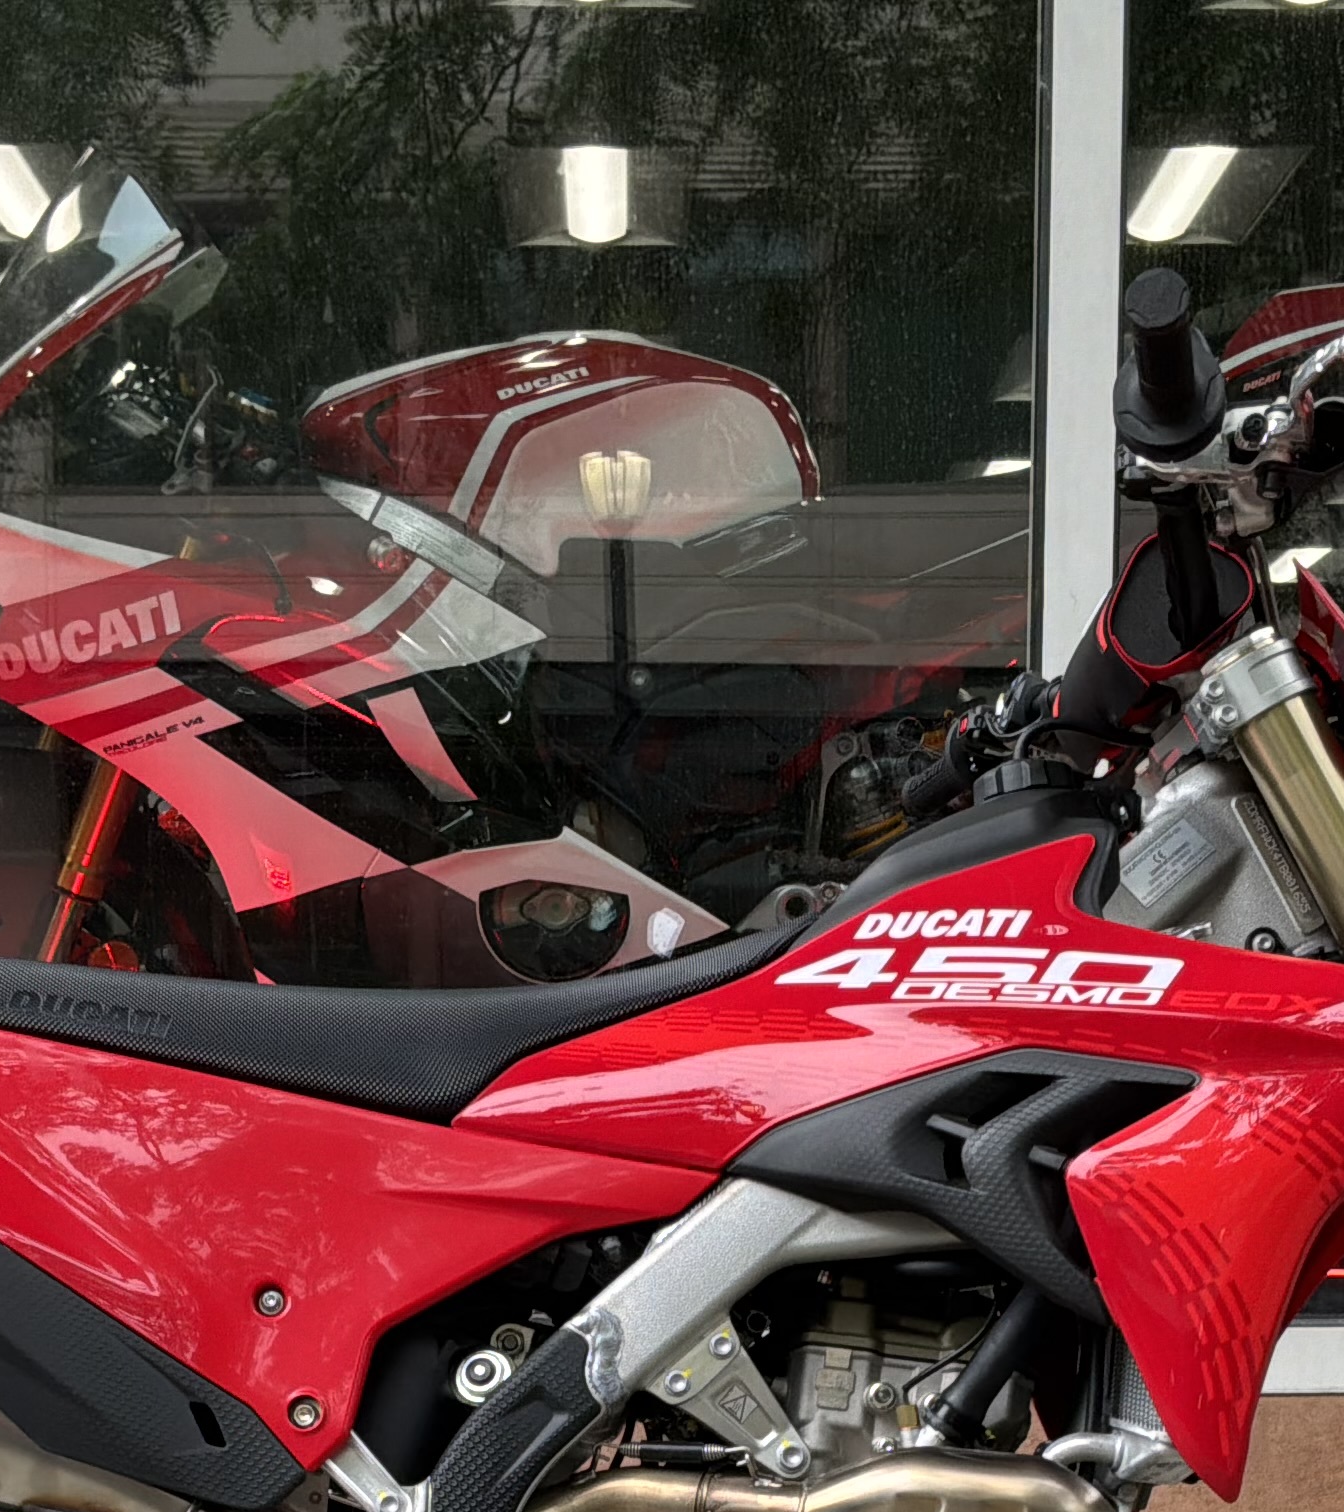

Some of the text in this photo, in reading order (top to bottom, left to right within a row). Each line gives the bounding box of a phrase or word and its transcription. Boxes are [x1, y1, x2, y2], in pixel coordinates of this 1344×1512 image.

[496, 366, 590, 401] DUCATI
[1242, 370, 1282, 393] DUCATI
[181, 715, 205, 729] V4
[853, 907, 1033, 940] DUCATI
[773, 946, 1186, 990] 450
[889, 980, 1166, 1007] DESMO
[8, 988, 174, 1039] DUCATI
